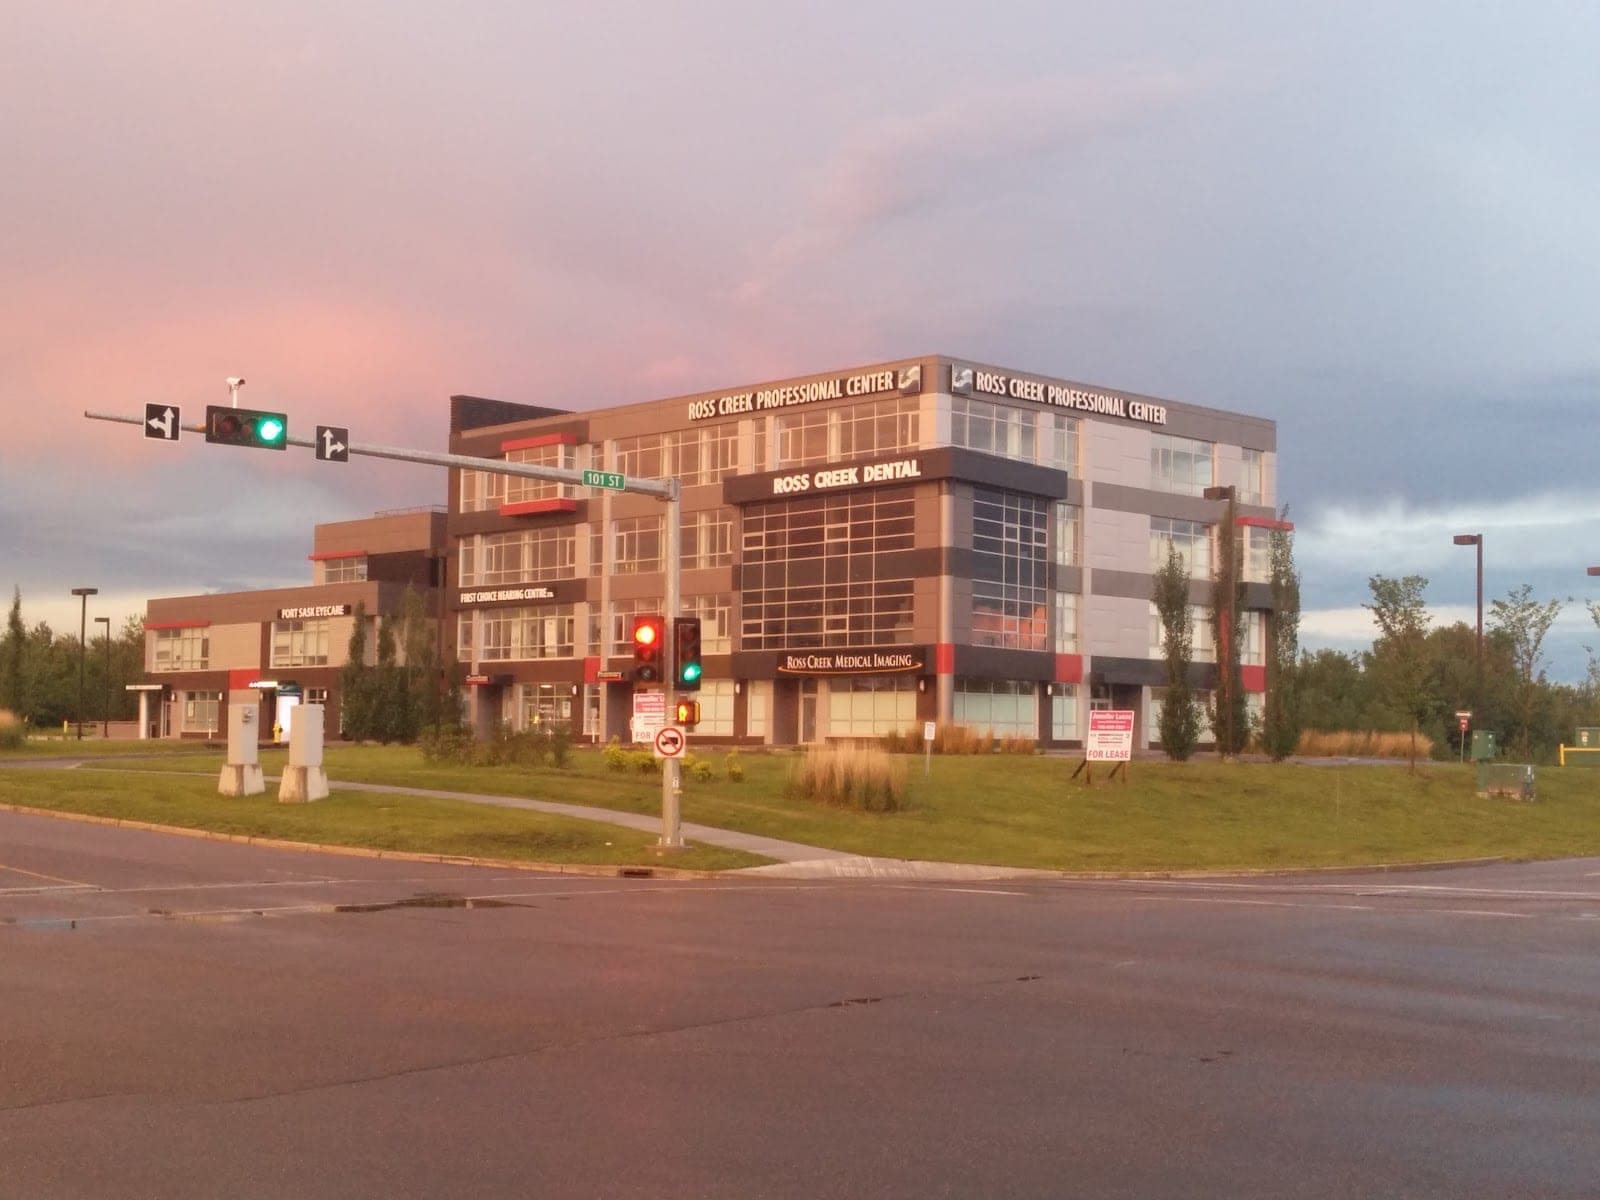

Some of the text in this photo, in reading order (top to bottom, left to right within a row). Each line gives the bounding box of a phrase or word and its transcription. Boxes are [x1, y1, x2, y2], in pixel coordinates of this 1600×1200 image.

[689, 371, 893, 420] ROSS CREEK PROFESSIONAL CENTER
[976, 372, 1167, 425] ROSS CREEK PROFESSIONAL CENTER
[588, 473, 620, 487] 101 ST
[773, 460, 921, 494] ROSS CREEK DENTAL
[460, 593, 476, 603] FIRST
[477, 591, 497, 602] CHOICE
[498, 589, 524, 601] HEARING
[524, 588, 547, 599] CENTRE
[299, 607, 315, 618] SASK
[316, 605, 344, 617] EYECARE
[635, 731, 651, 740] FOR
[1088, 750, 1129, 759] FOR LEASE
